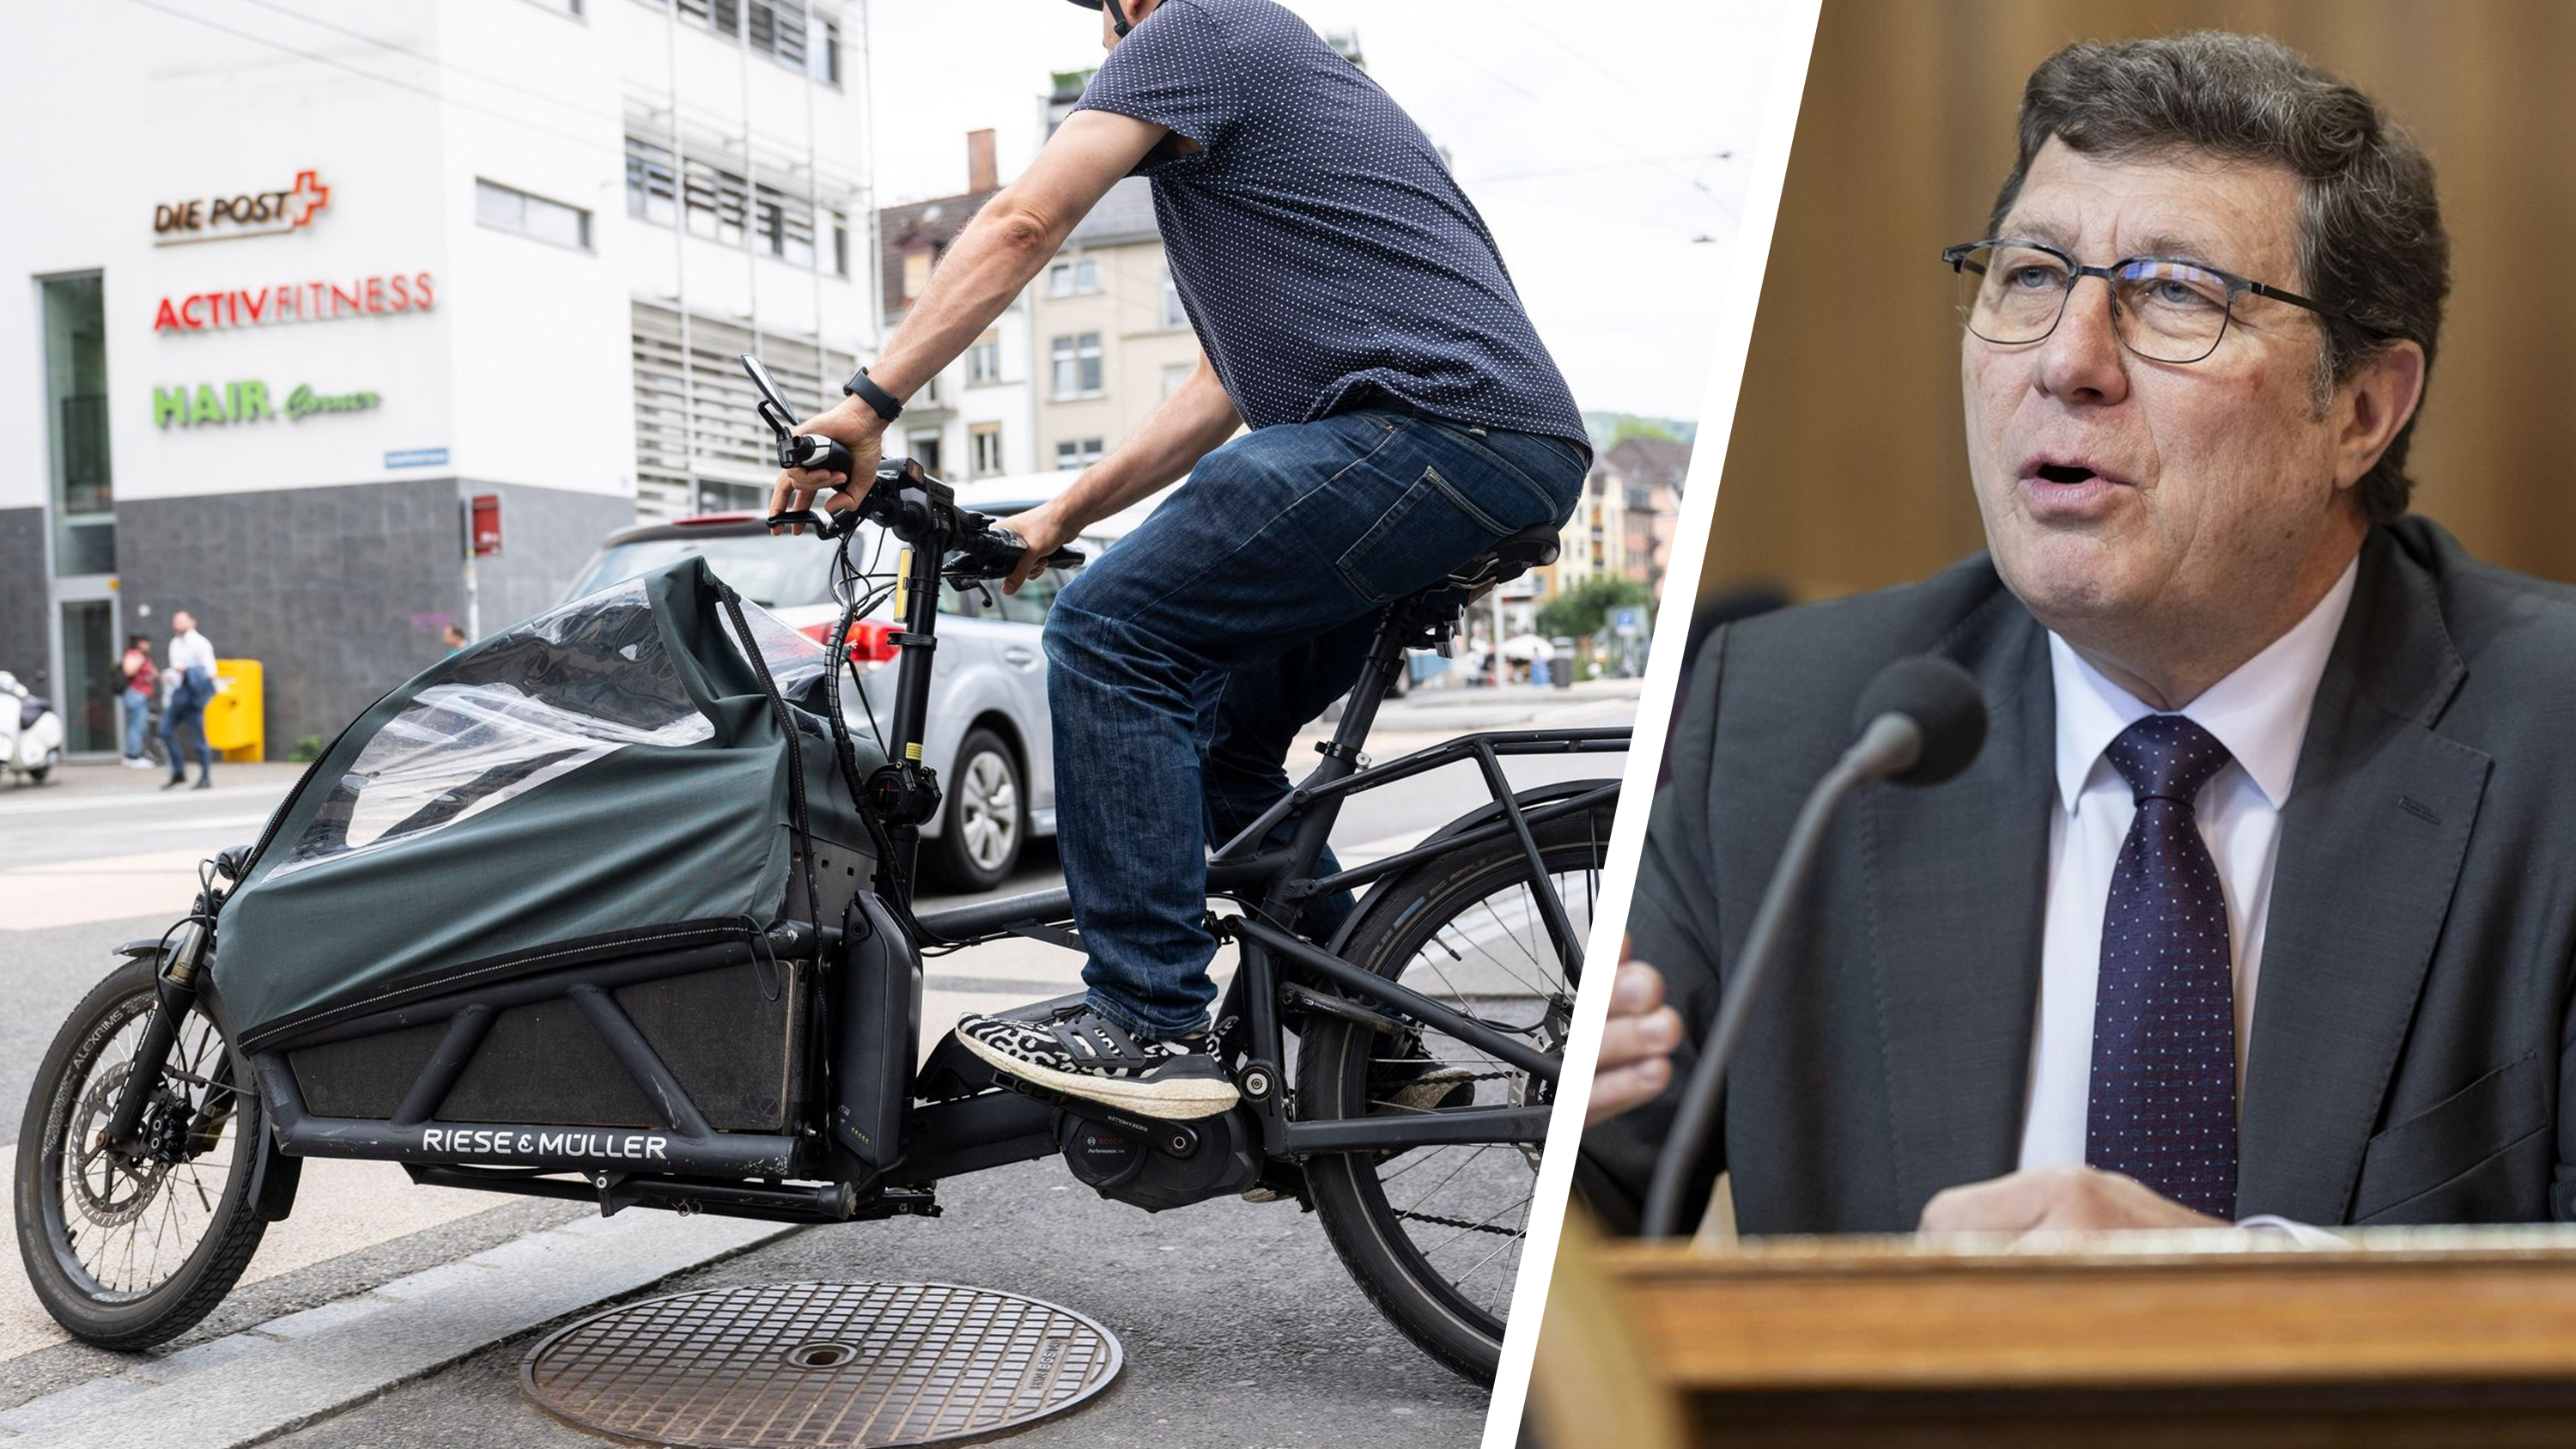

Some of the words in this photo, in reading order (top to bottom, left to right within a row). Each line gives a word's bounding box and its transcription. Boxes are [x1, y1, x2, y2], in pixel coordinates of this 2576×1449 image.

[154, 200, 203, 234] DIE
[210, 191, 291, 226] POST
[73, 1009, 124, 1070] ALEXRIMS
[423, 1129, 514, 1154] RIESE
[517, 1133, 534, 1154] &
[538, 1132, 667, 1160] MÜLLER
[1097, 1136, 1125, 1145] BOSCH
